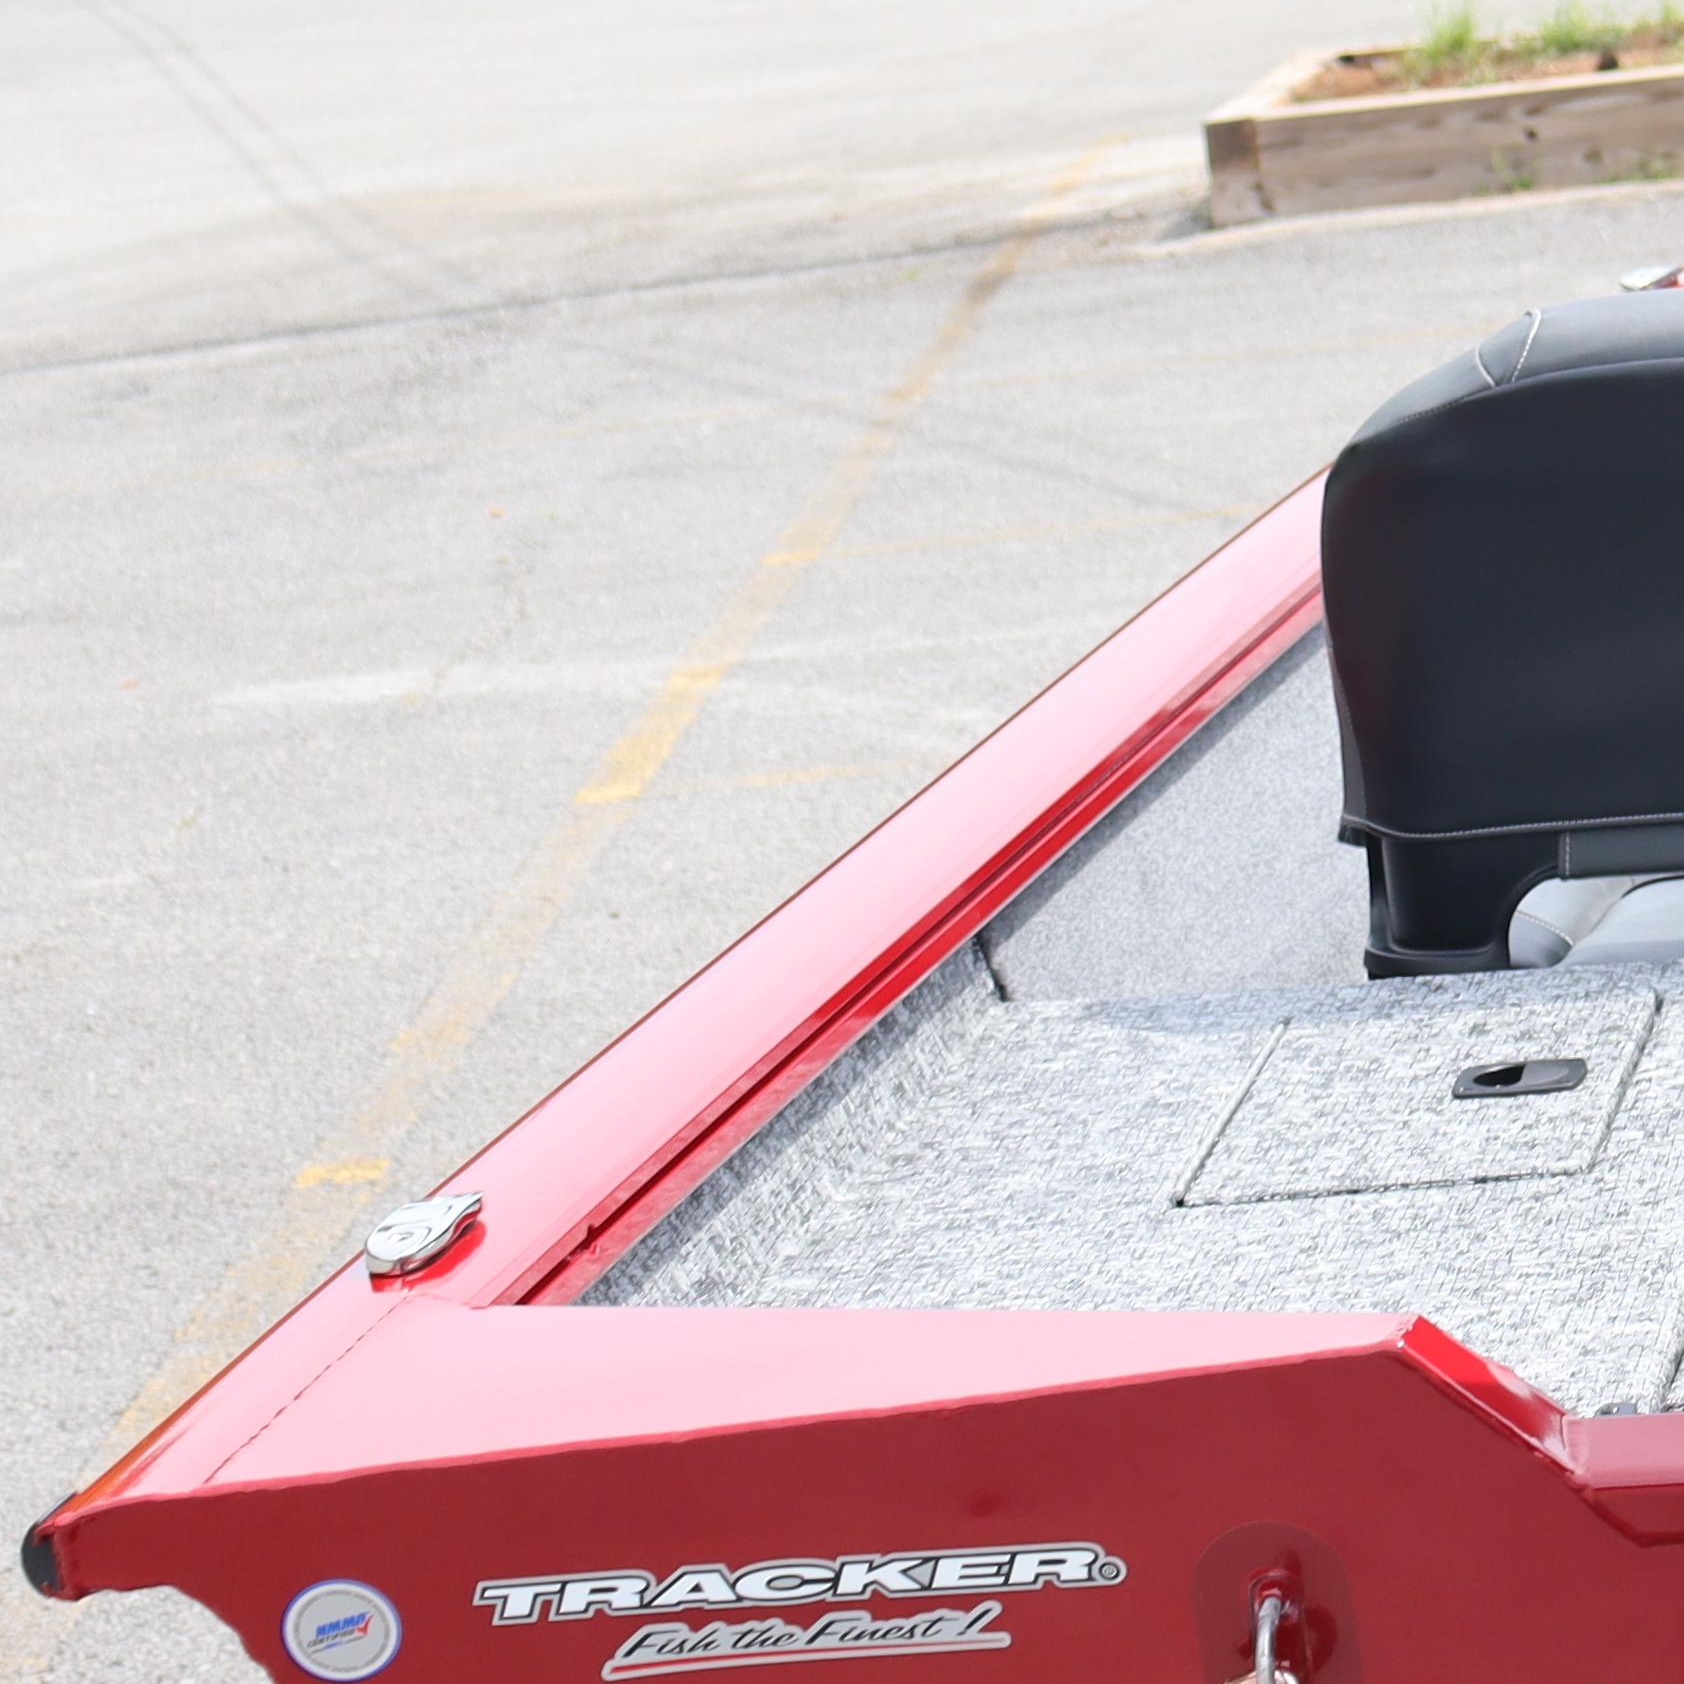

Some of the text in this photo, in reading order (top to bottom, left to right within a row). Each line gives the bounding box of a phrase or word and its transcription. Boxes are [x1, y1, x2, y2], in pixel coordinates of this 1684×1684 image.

[622, 1627, 721, 1659] Fish
[731, 1624, 801, 1650] the
[805, 1612, 942, 1647] Finest
